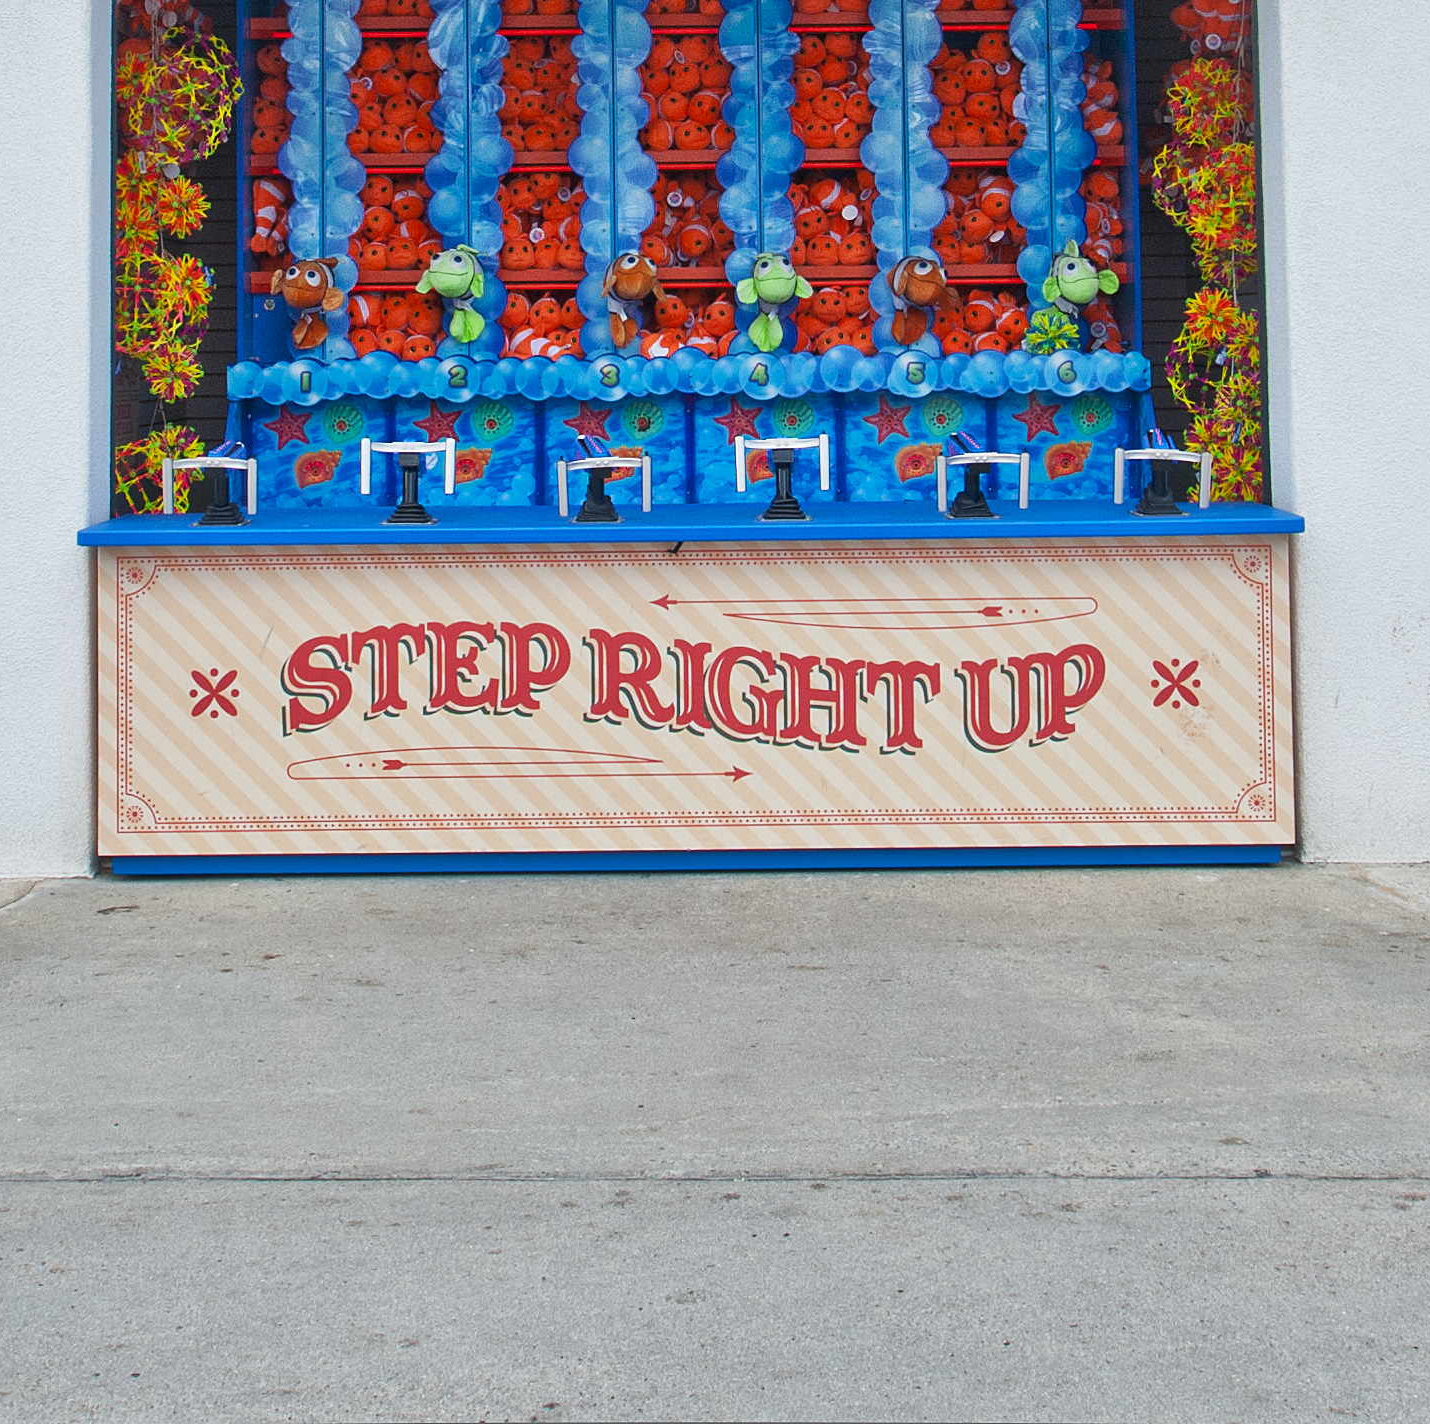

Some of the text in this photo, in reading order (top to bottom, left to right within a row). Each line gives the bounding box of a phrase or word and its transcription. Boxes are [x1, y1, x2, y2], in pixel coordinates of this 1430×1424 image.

[300, 371, 312, 393] 1
[448, 365, 468, 388] 2
[600, 363, 620, 387] 3
[749, 362, 769, 386] 4
[905, 361, 926, 385] 5
[1056, 360, 1077, 384] 6
[281, 619, 1107, 755] STEP RIGHT UP
